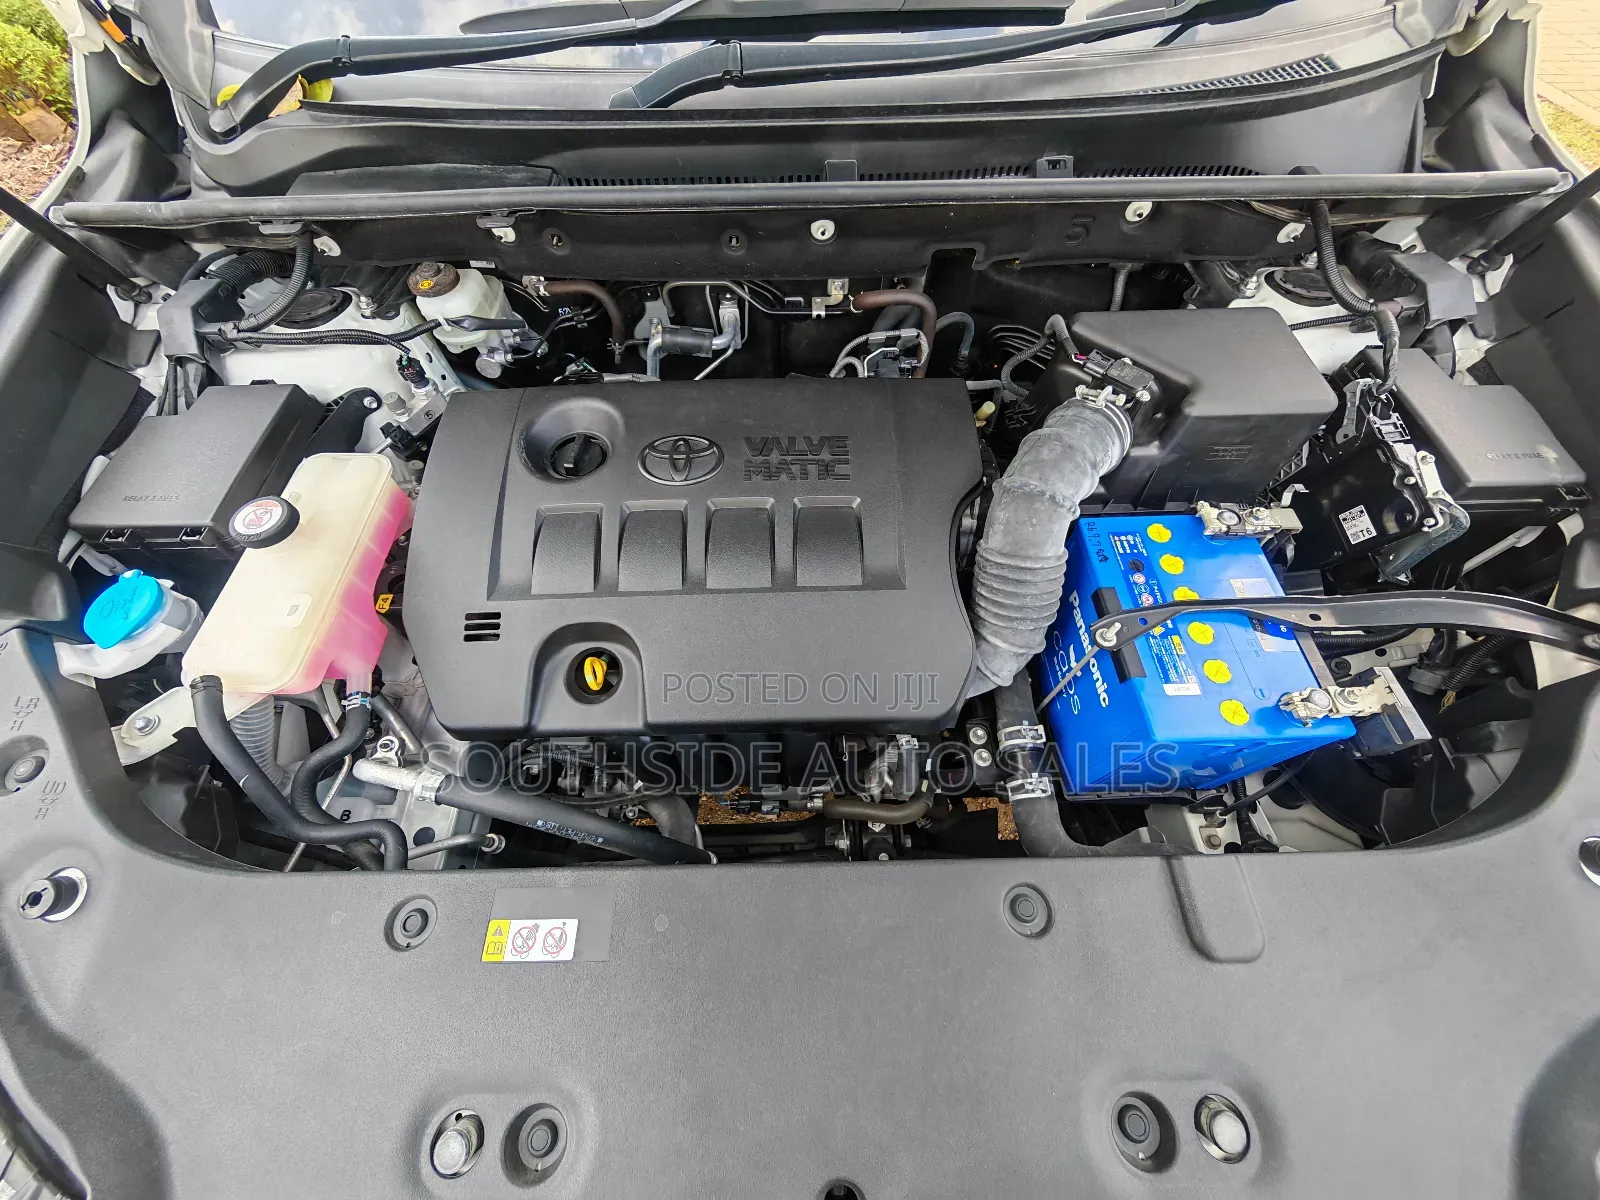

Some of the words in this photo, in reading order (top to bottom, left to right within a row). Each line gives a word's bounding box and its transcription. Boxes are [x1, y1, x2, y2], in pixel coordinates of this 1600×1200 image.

[743, 435, 849, 457] VALVE
[743, 458, 850, 481] MATIC
[1359, 527, 1373, 538] T6
[1068, 589, 1109, 708] Panasonic
